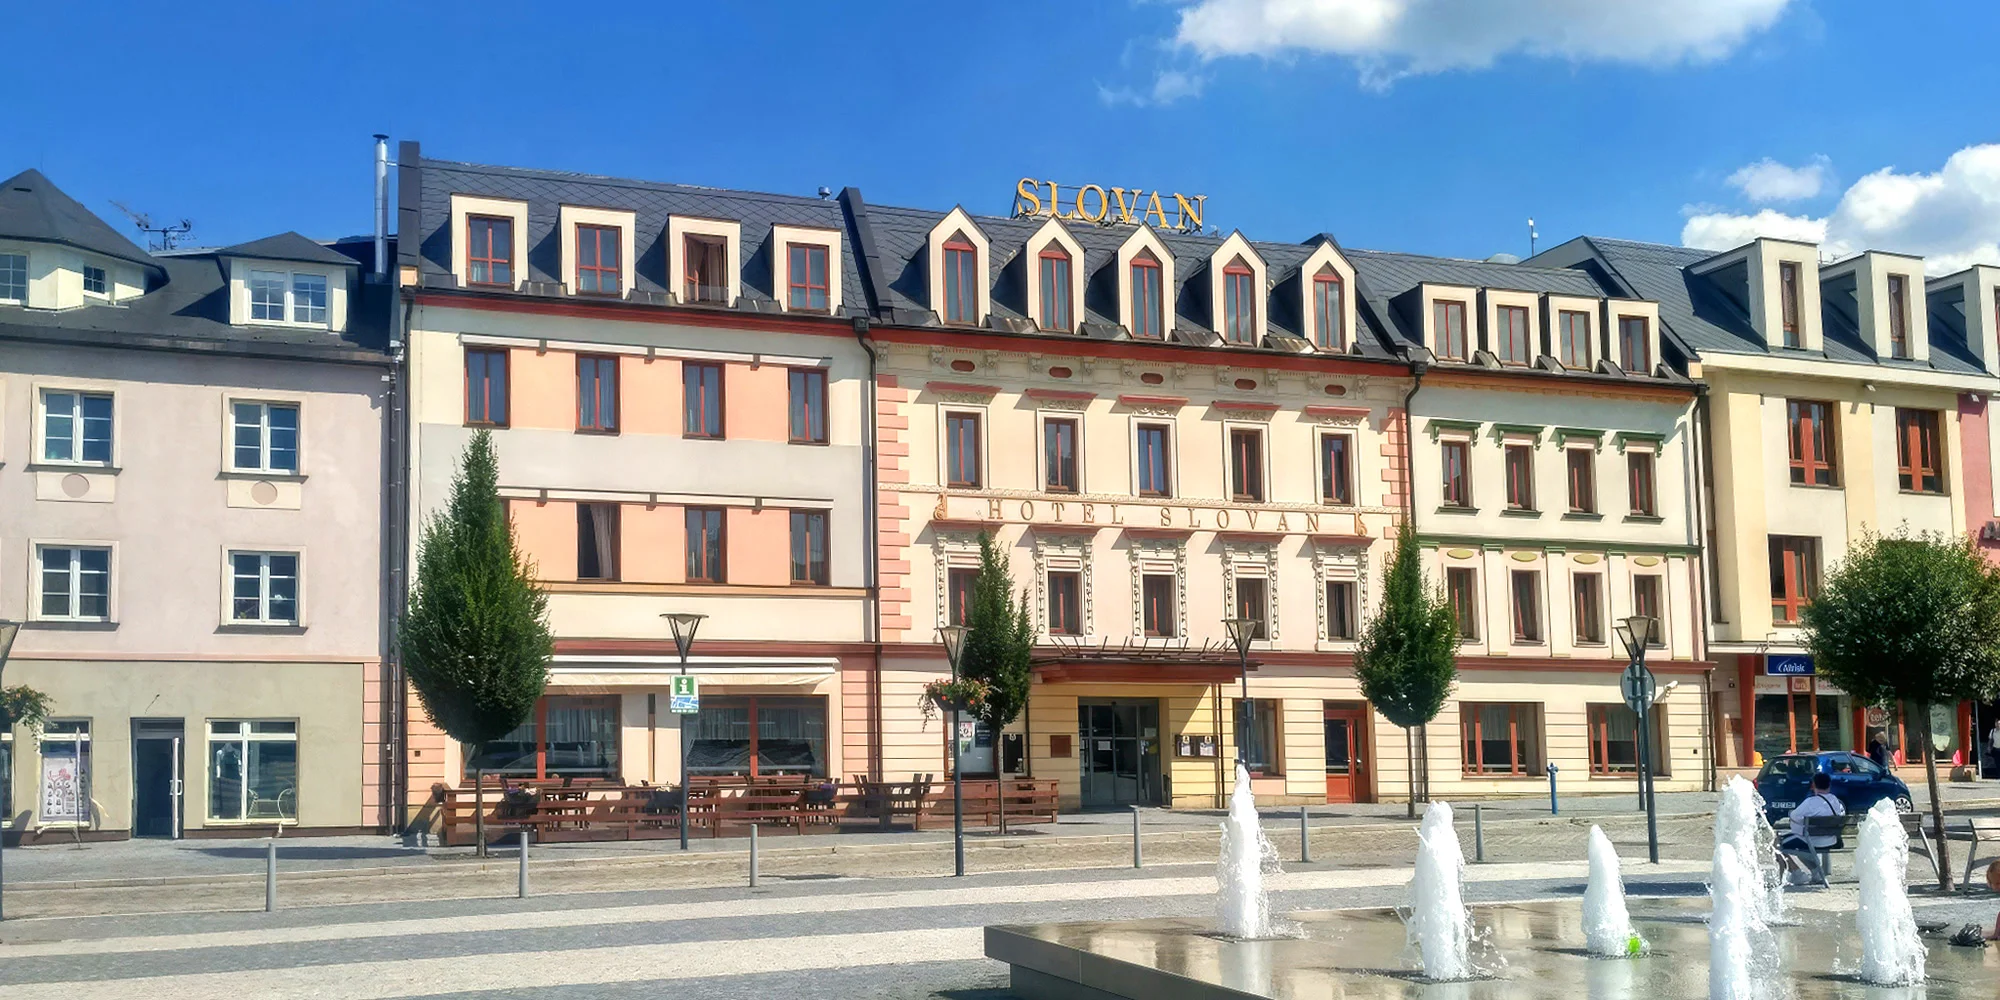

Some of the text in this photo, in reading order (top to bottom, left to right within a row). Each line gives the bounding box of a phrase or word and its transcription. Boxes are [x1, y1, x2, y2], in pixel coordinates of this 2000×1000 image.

[1017, 177, 1208, 229] SLOVAN
[987, 498, 1320, 532] HOTEL SLOVAN
